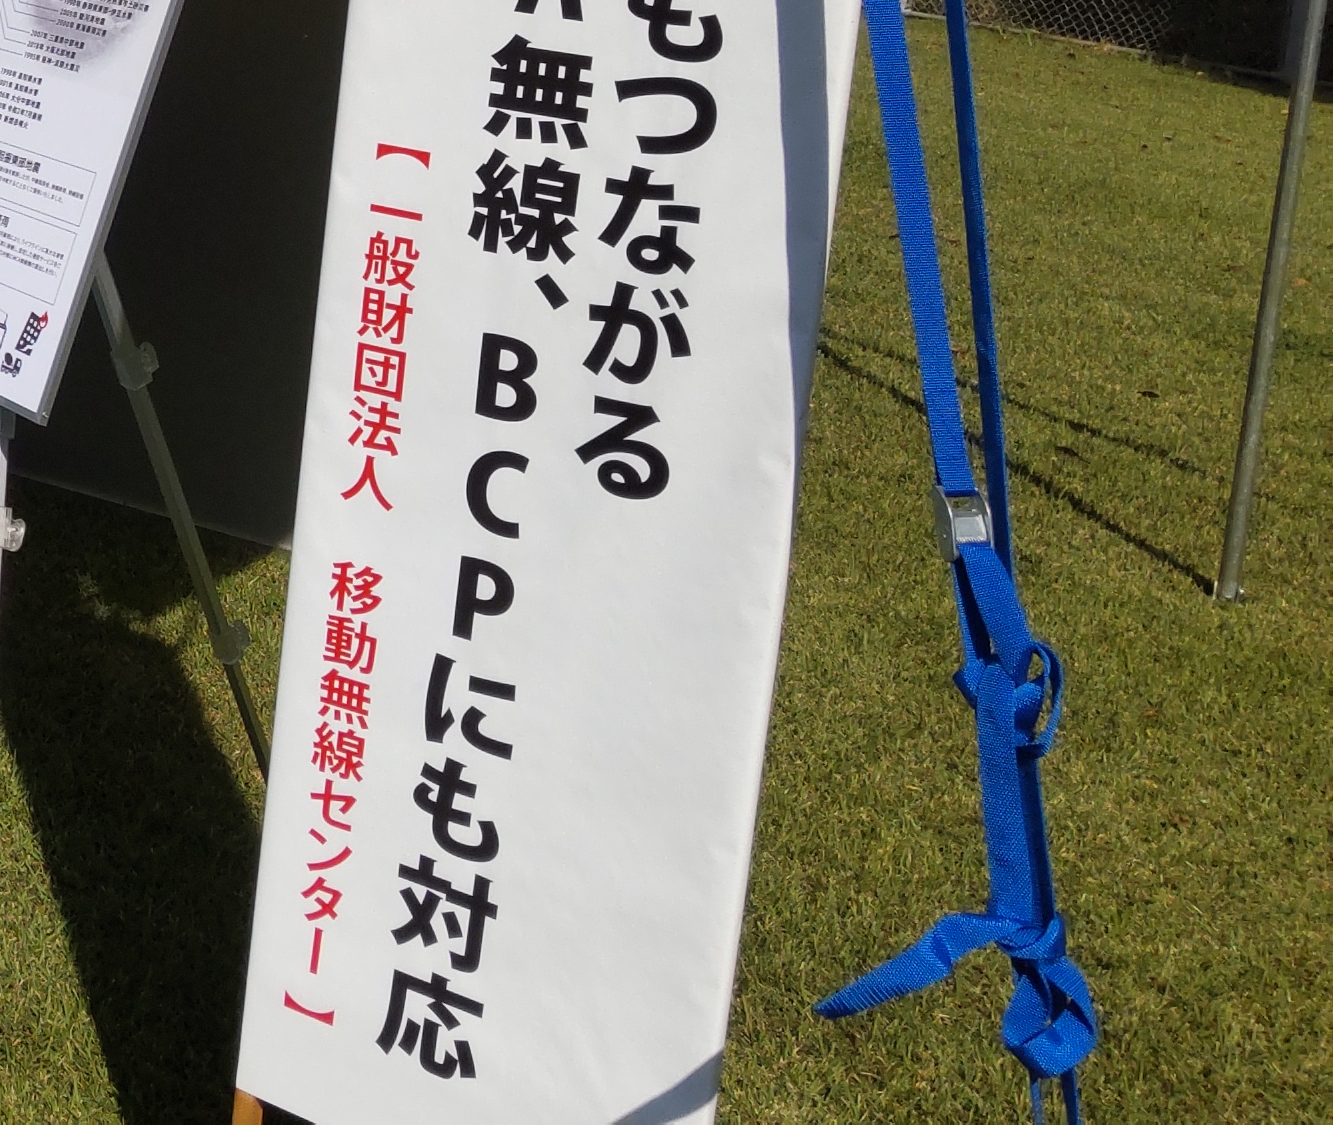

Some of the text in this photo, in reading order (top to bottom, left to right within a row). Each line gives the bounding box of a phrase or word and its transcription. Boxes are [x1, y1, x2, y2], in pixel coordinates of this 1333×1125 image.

[284, 143, 431, 1027] 【一般財団法人 移動無線センター】
